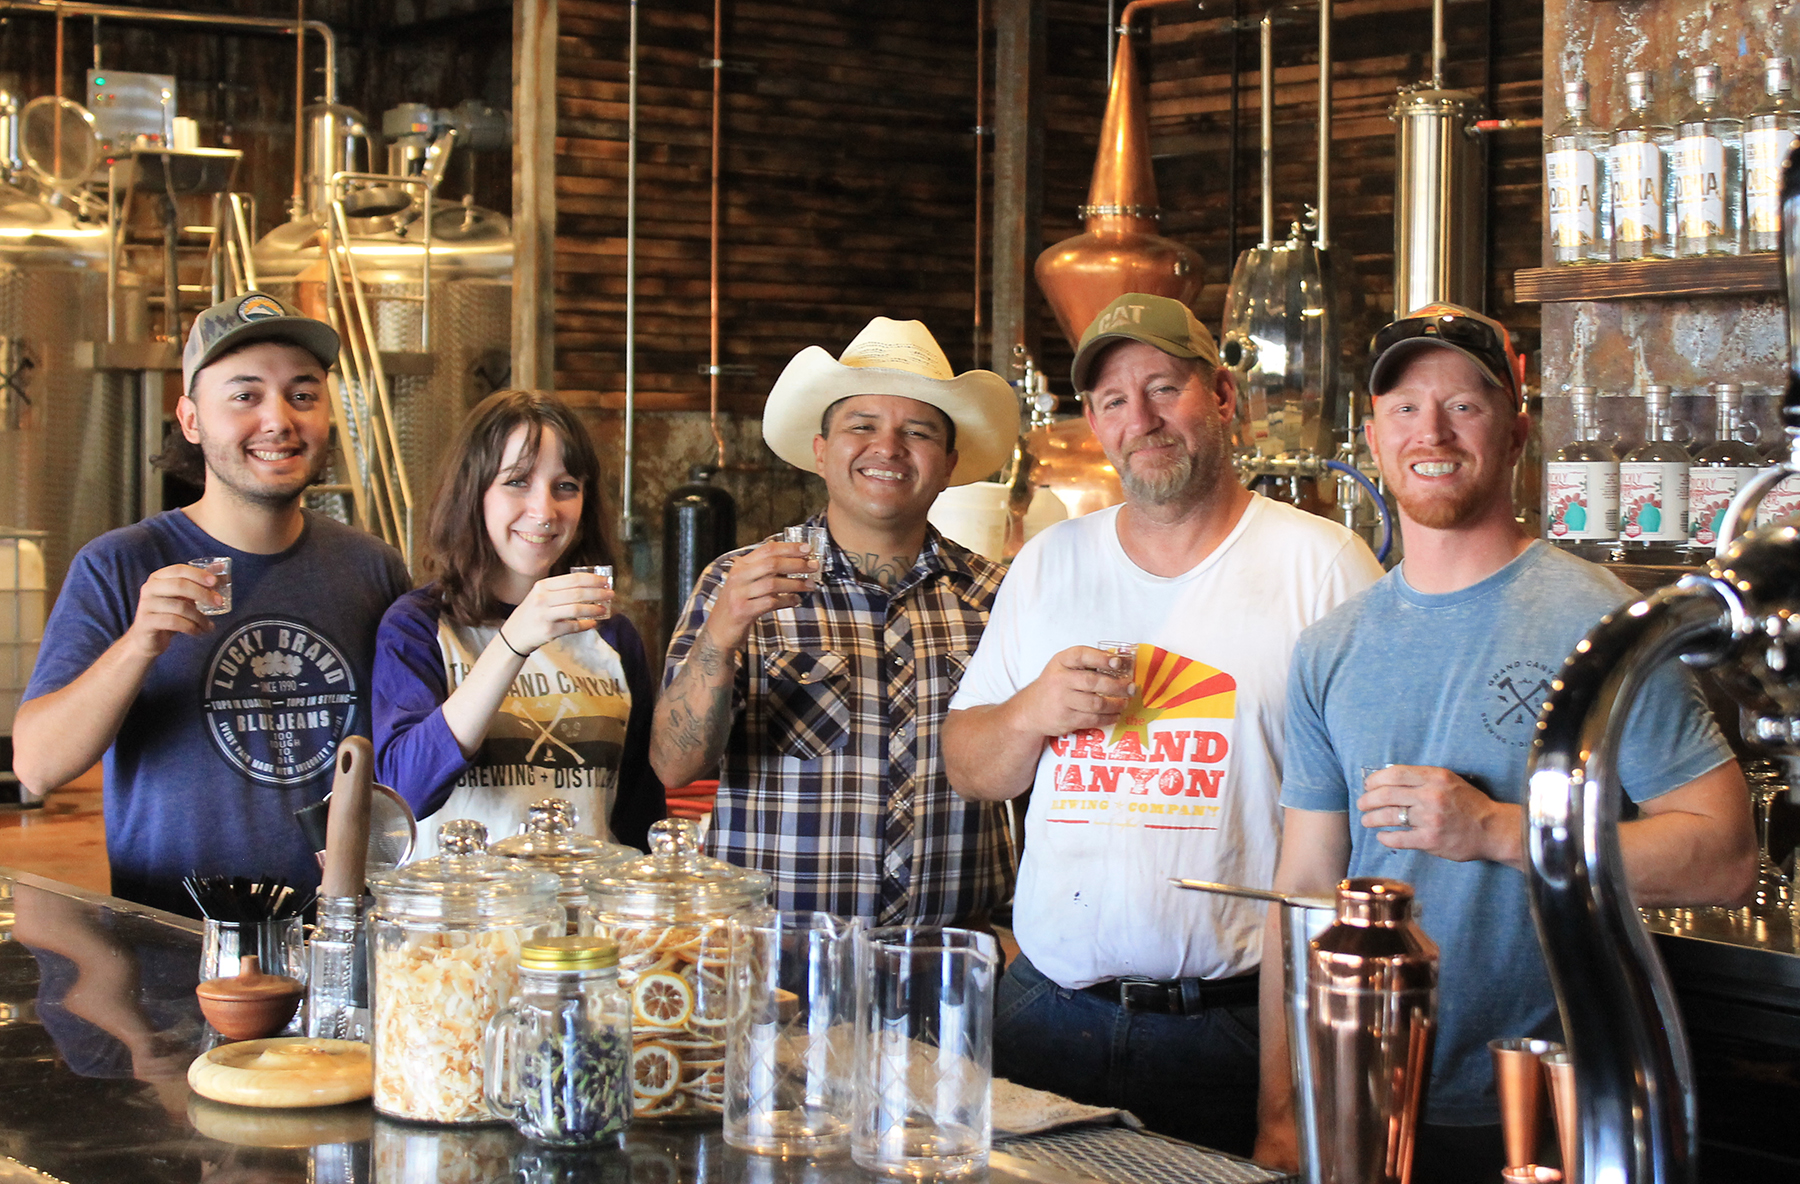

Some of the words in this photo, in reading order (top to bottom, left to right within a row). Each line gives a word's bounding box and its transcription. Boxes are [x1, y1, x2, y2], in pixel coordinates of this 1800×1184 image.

[1098, 304, 1145, 334] CAT
[214, 629, 264, 690] LUCKY
[278, 628, 345, 685] BRAND
[449, 662, 472, 688] TH
[507, 672, 550, 698] AND
[556, 670, 624, 699] CANYON
[1488, 661, 1521, 687] GRAND
[1526, 660, 1558, 681] CANYO
[278, 679, 297, 692] 1990
[211, 699, 233, 710] TOPS
[287, 697, 305, 707] TOPS
[306, 695, 317, 706] IN
[317, 694, 350, 705] STYLING
[1125, 715, 1145, 726] the
[273, 731, 293, 740] TOO
[270, 739, 301, 748] TOUGH
[1050, 728, 1229, 764] GRAND
[278, 747, 291, 756] TO
[250, 758, 274, 773] MADE
[277, 755, 295, 764] DIE
[1127, 802, 1221, 817] COMPANY
